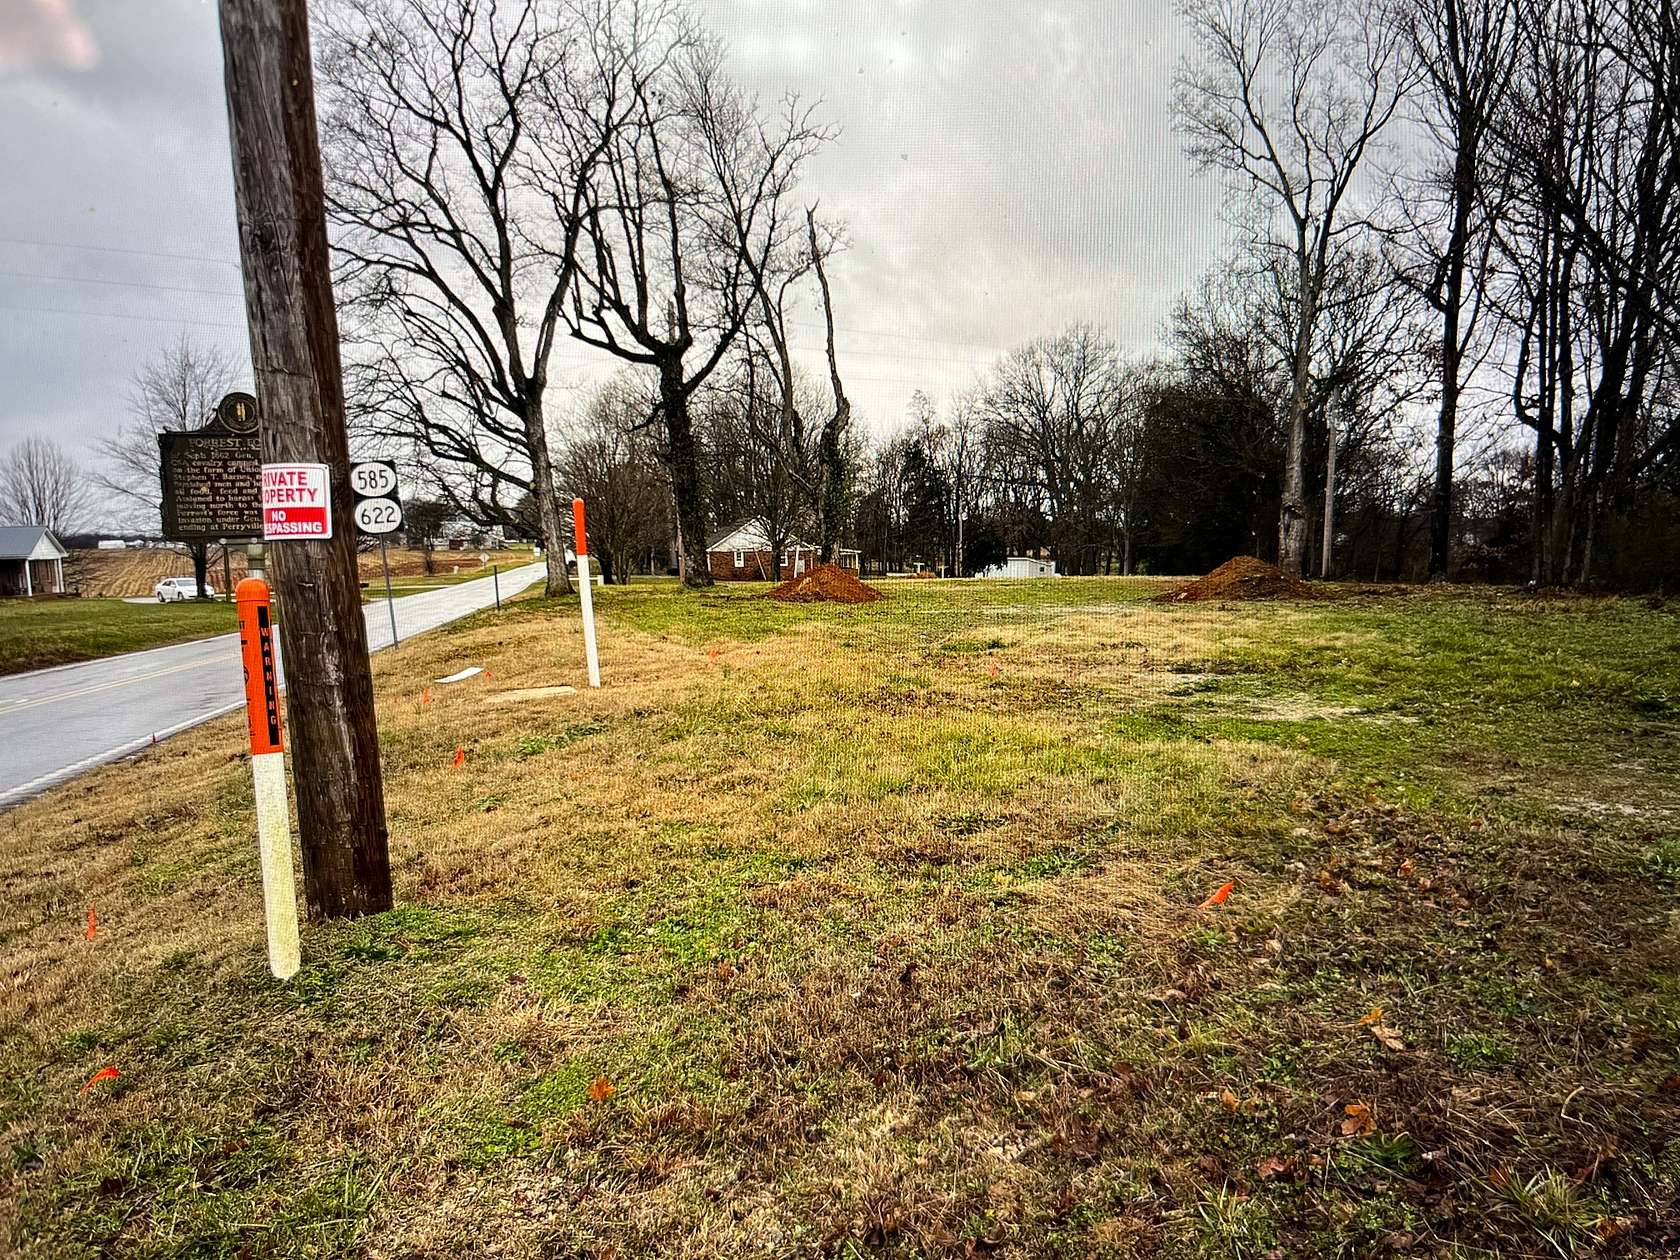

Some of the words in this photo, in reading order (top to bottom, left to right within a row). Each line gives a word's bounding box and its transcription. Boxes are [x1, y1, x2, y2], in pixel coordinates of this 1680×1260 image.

[189, 438, 242, 447] FORREST
[358, 470, 389, 489] 585
[220, 487, 238, 495] feed
[242, 487, 257, 495] and
[271, 510, 287, 522] NO
[361, 506, 396, 525] 622
[178, 523, 206, 532] ending
[260, 627, 277, 725] WARNING
